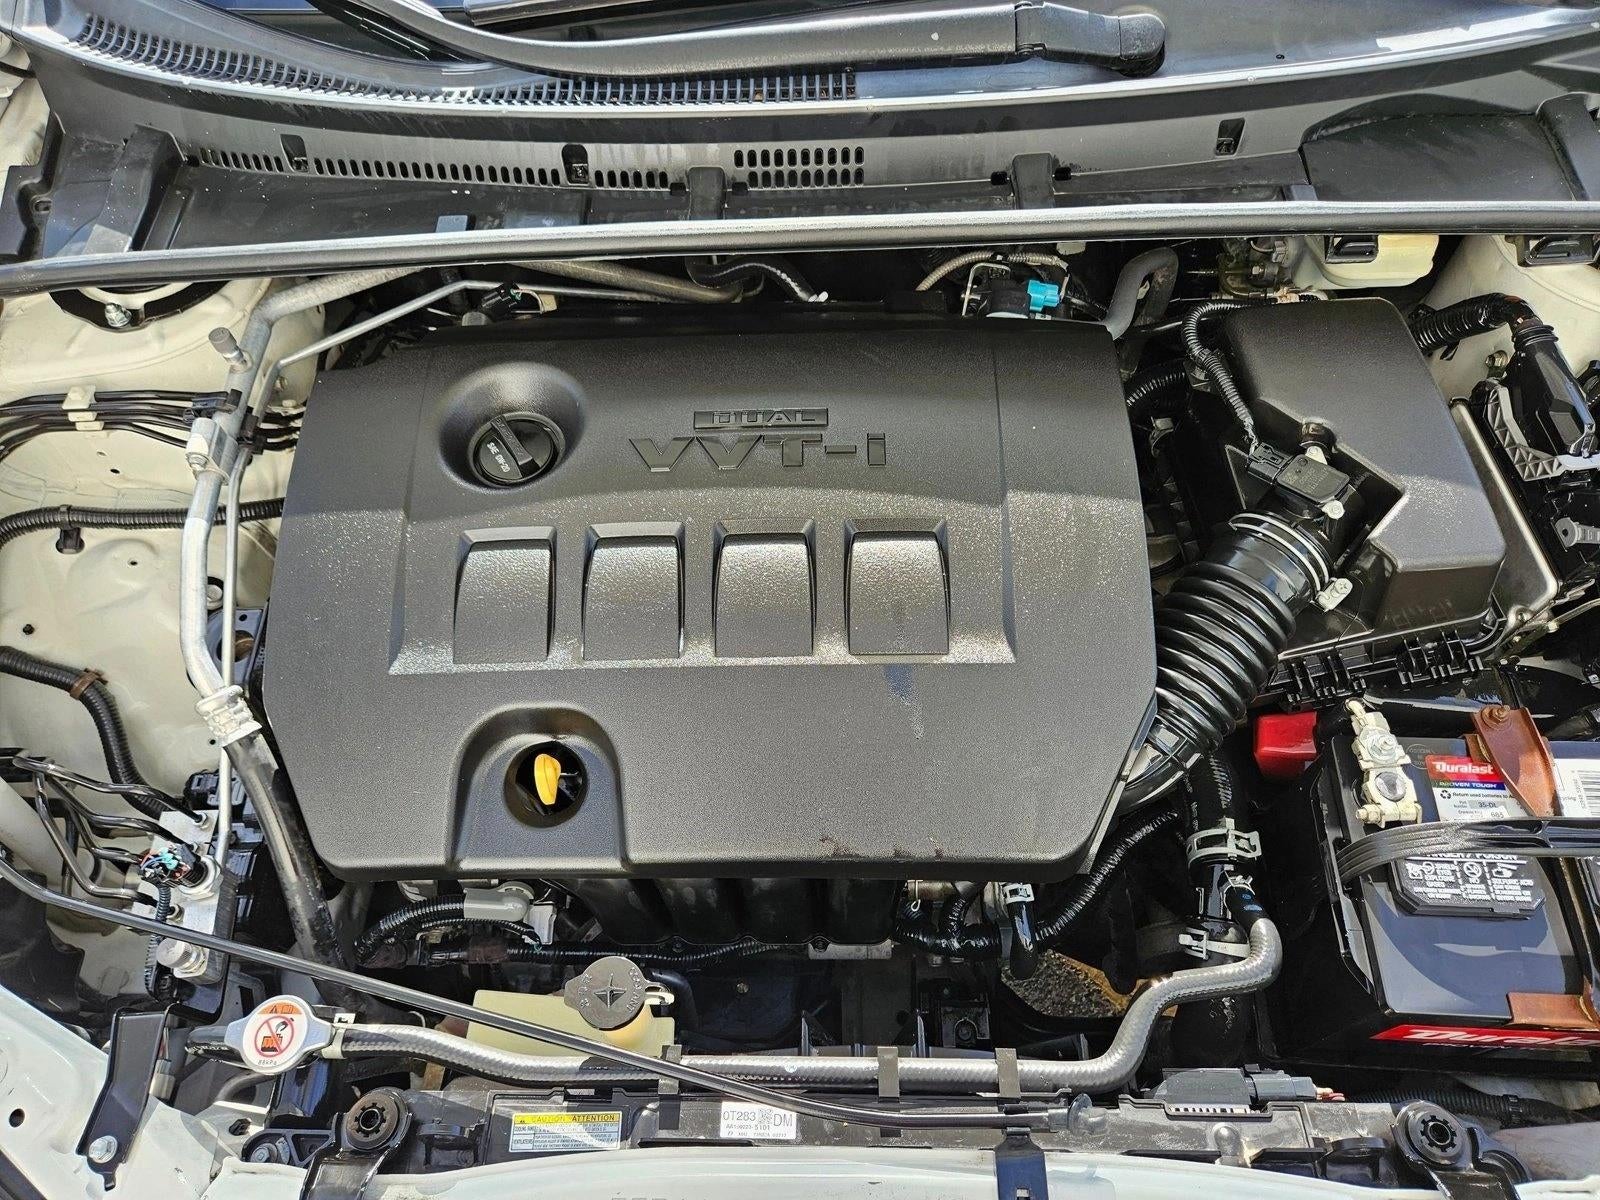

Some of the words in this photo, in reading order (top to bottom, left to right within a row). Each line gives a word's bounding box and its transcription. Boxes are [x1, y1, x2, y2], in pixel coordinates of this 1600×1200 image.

[712, 410, 816, 425] DUAL
[1432, 761, 1494, 775] Duralast
[571, 1114, 616, 1123] ATTENTION
[773, 1113, 794, 1127] DM
